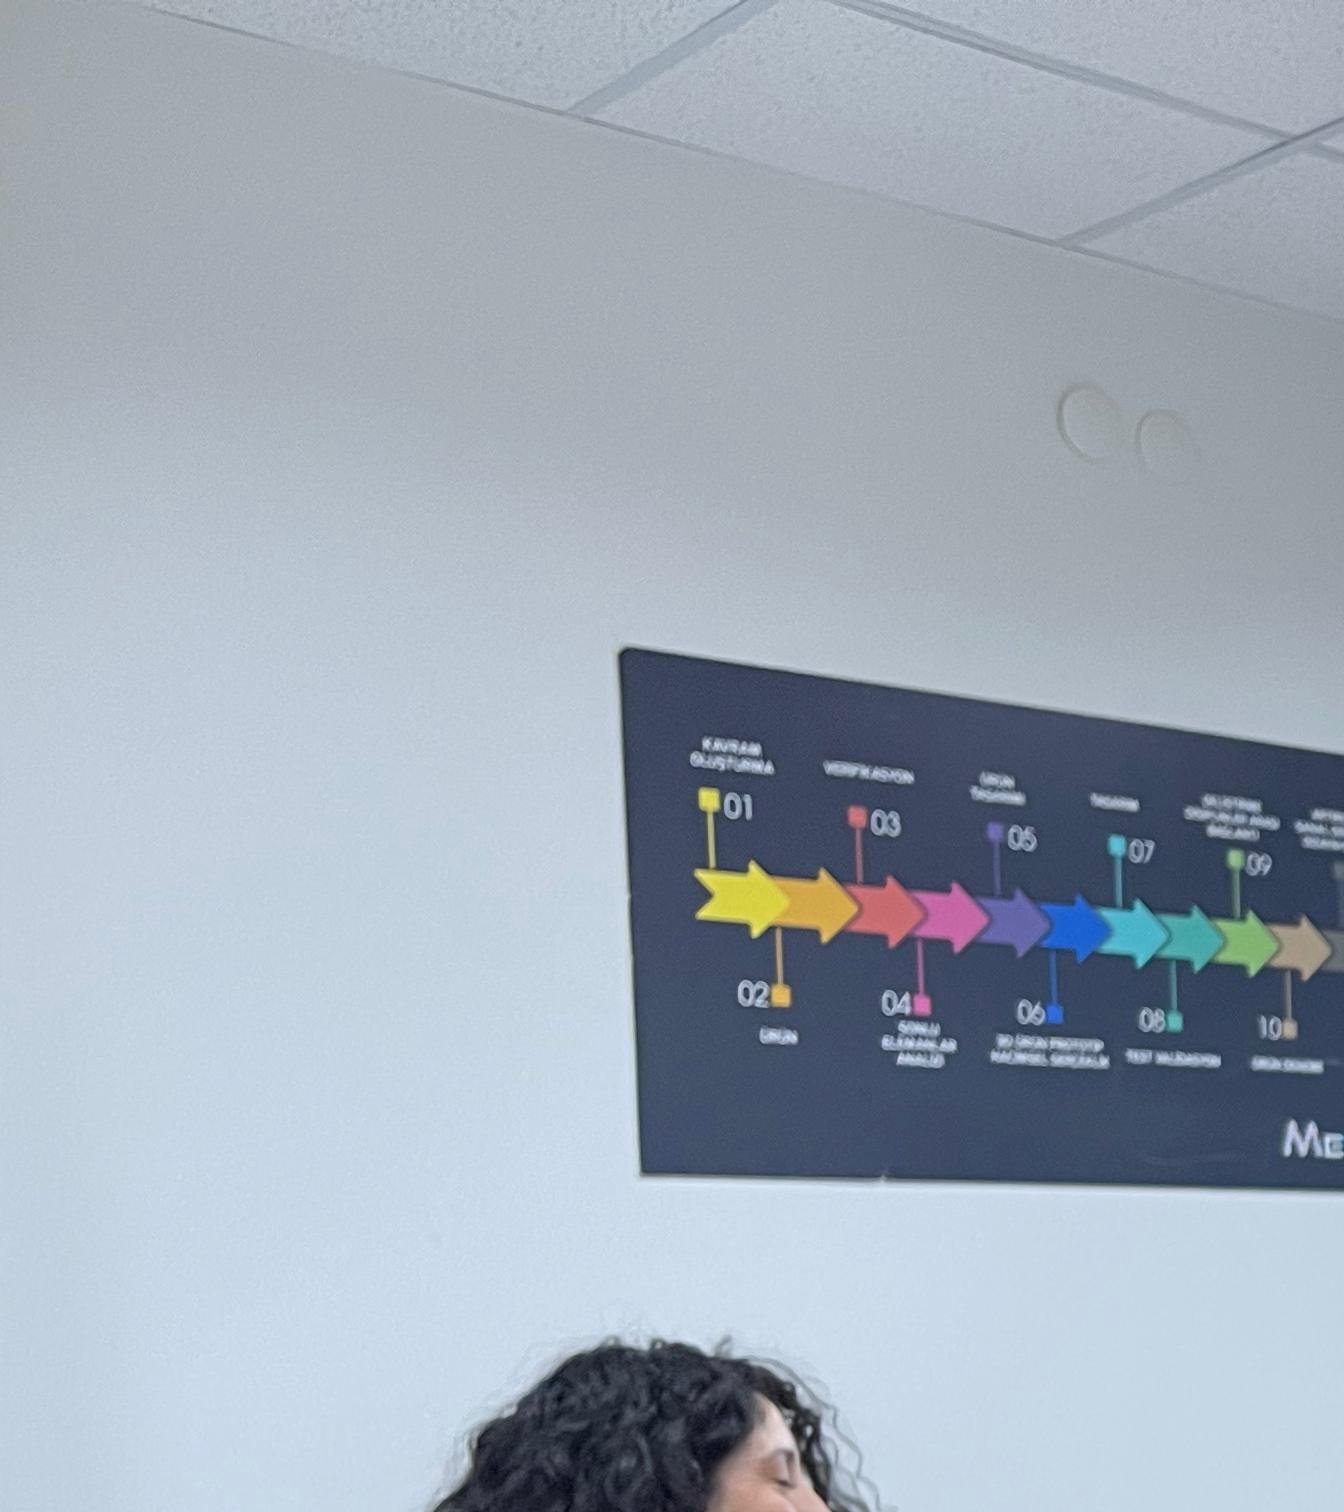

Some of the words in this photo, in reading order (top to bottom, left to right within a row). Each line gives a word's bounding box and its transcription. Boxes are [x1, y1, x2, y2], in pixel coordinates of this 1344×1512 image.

[724, 792, 752, 821] 01
[870, 809, 901, 838] 03
[1008, 824, 1038, 852] 05
[1129, 838, 1155, 864] 07
[1246, 852, 1272, 876] 09
[737, 979, 770, 1008] 02
[882, 989, 912, 1017] 04
[1017, 998, 1045, 1026] 06
[1138, 1006, 1166, 1033] 08
[1257, 1015, 1282, 1040] 10
